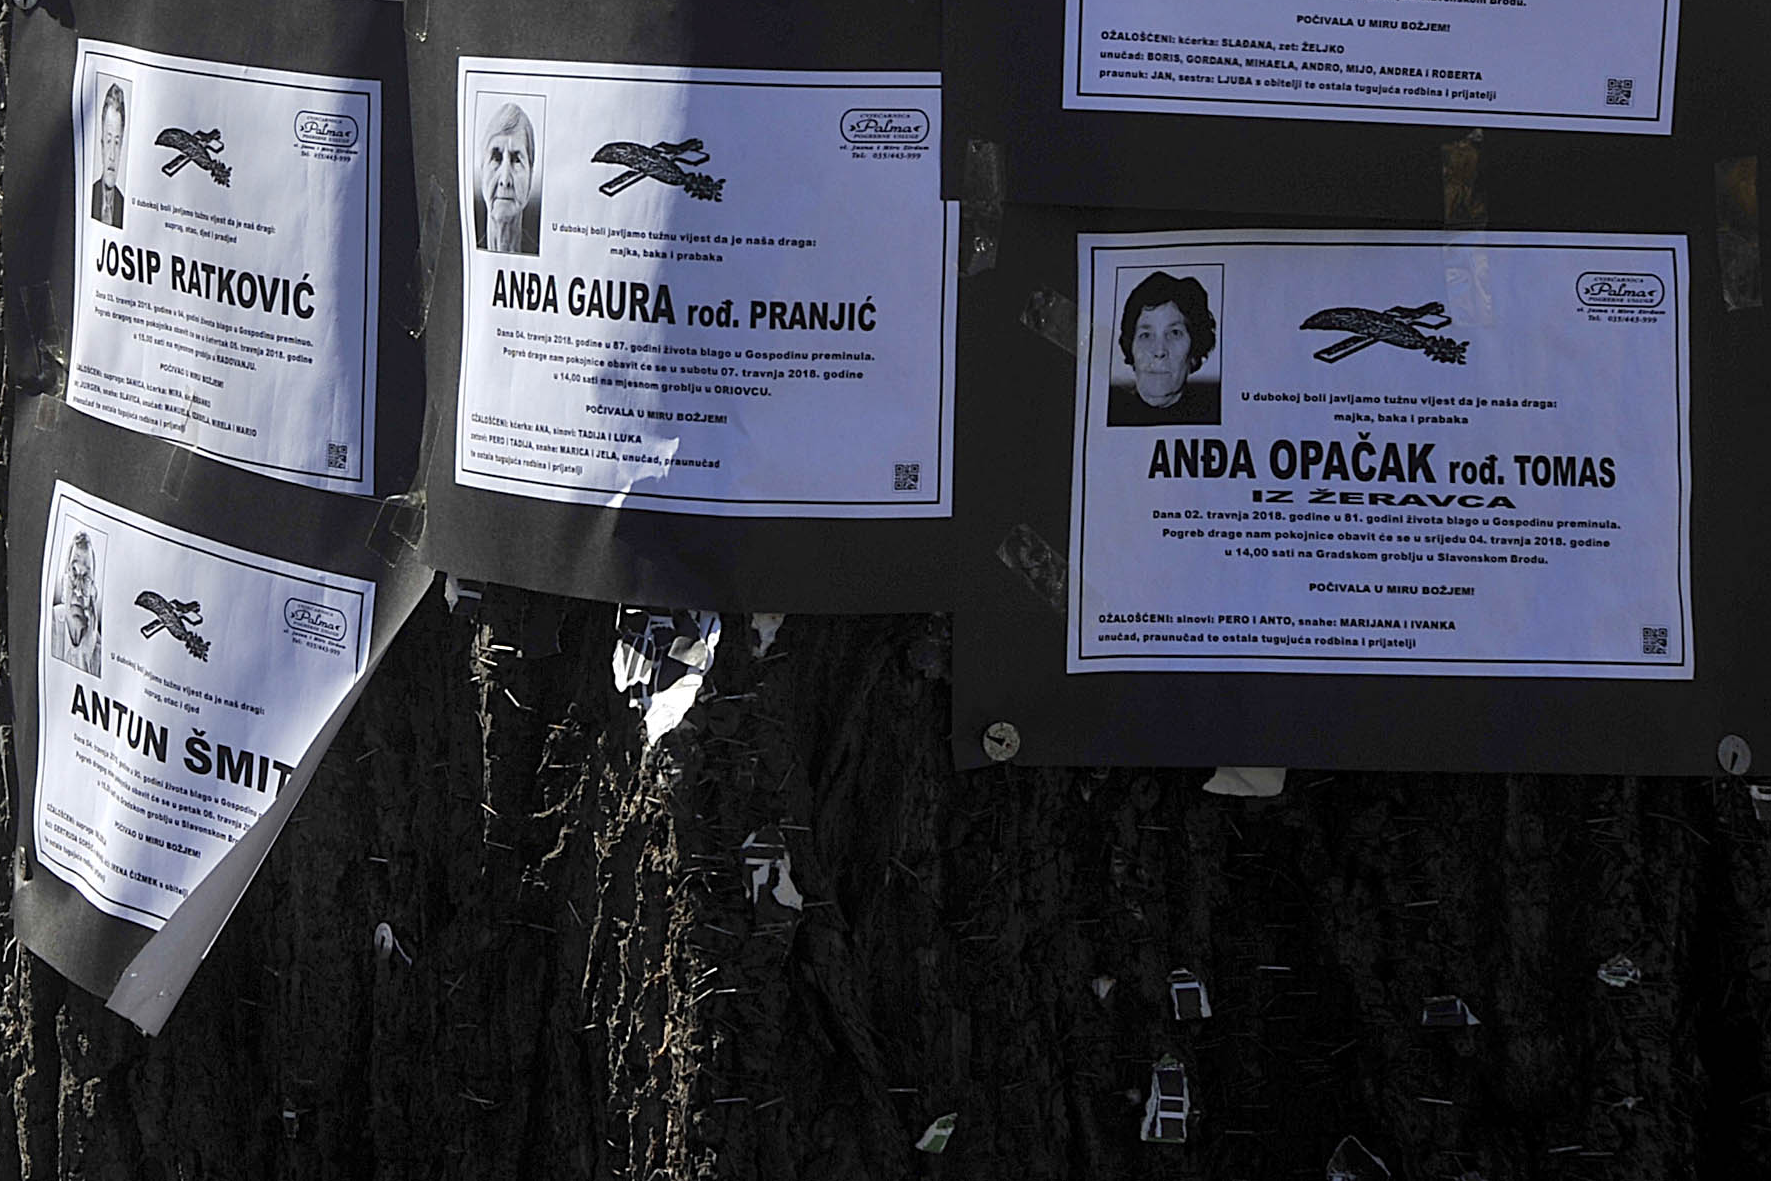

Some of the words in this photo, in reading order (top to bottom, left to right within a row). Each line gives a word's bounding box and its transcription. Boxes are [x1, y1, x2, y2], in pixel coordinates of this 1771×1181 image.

[1296, 14, 1354, 26] POČIVALA
[1368, 19, 1398, 29] MIRU
[1300, 41, 1344, 54] ŽELJKO
[1378, 65, 1423, 77] ANDREA
[1431, 68, 1482, 80] ROBERTA
[304, 121, 344, 137] Palma
[856, 119, 912, 133] Palma
[642, 248, 667, 259] baka
[676, 252, 723, 262] prabaka
[96, 238, 160, 285] JOSIP
[171, 255, 314, 319] RATKOVIĆ
[1590, 283, 1646, 297] Palma
[492, 269, 558, 314] ANĐA
[568, 276, 675, 324] GAURA
[689, 300, 738, 327] rođ.
[751, 296, 876, 331] PRANJIĆ
[614, 378, 659, 390] mjesnom
[660, 382, 702, 394] groblju
[585, 403, 634, 417] POČIVALA
[646, 410, 673, 421] MIRU
[1377, 412, 1407, 423] baka
[1417, 414, 1468, 425] prabaka
[1147, 438, 1256, 479] ANĐA
[1269, 432, 1437, 486] OPAČAK
[1449, 454, 1504, 485] rođ.
[1513, 455, 1616, 488] TOMAS
[1252, 489, 1294, 503] IZ
[1307, 487, 1516, 509] ŽERAVCA
[1308, 581, 1371, 593] POČIVALA
[1386, 584, 1418, 595] MIRU
[294, 609, 334, 630] Palma
[1217, 614, 1249, 624] PERO
[1339, 617, 1401, 628] MARIJANA
[1410, 619, 1456, 630] IVANKA
[1142, 632, 1204, 643] praunučad
[1207, 633, 1219, 642] te
[1221, 633, 1258, 643] ostala
[1261, 634, 1311, 646] tugujuća
[1314, 636, 1359, 646] rodbina
[1368, 637, 1416, 649] prijatelji
[71, 683, 168, 763] ANTUN
[183, 727, 295, 797] ŠMIT
